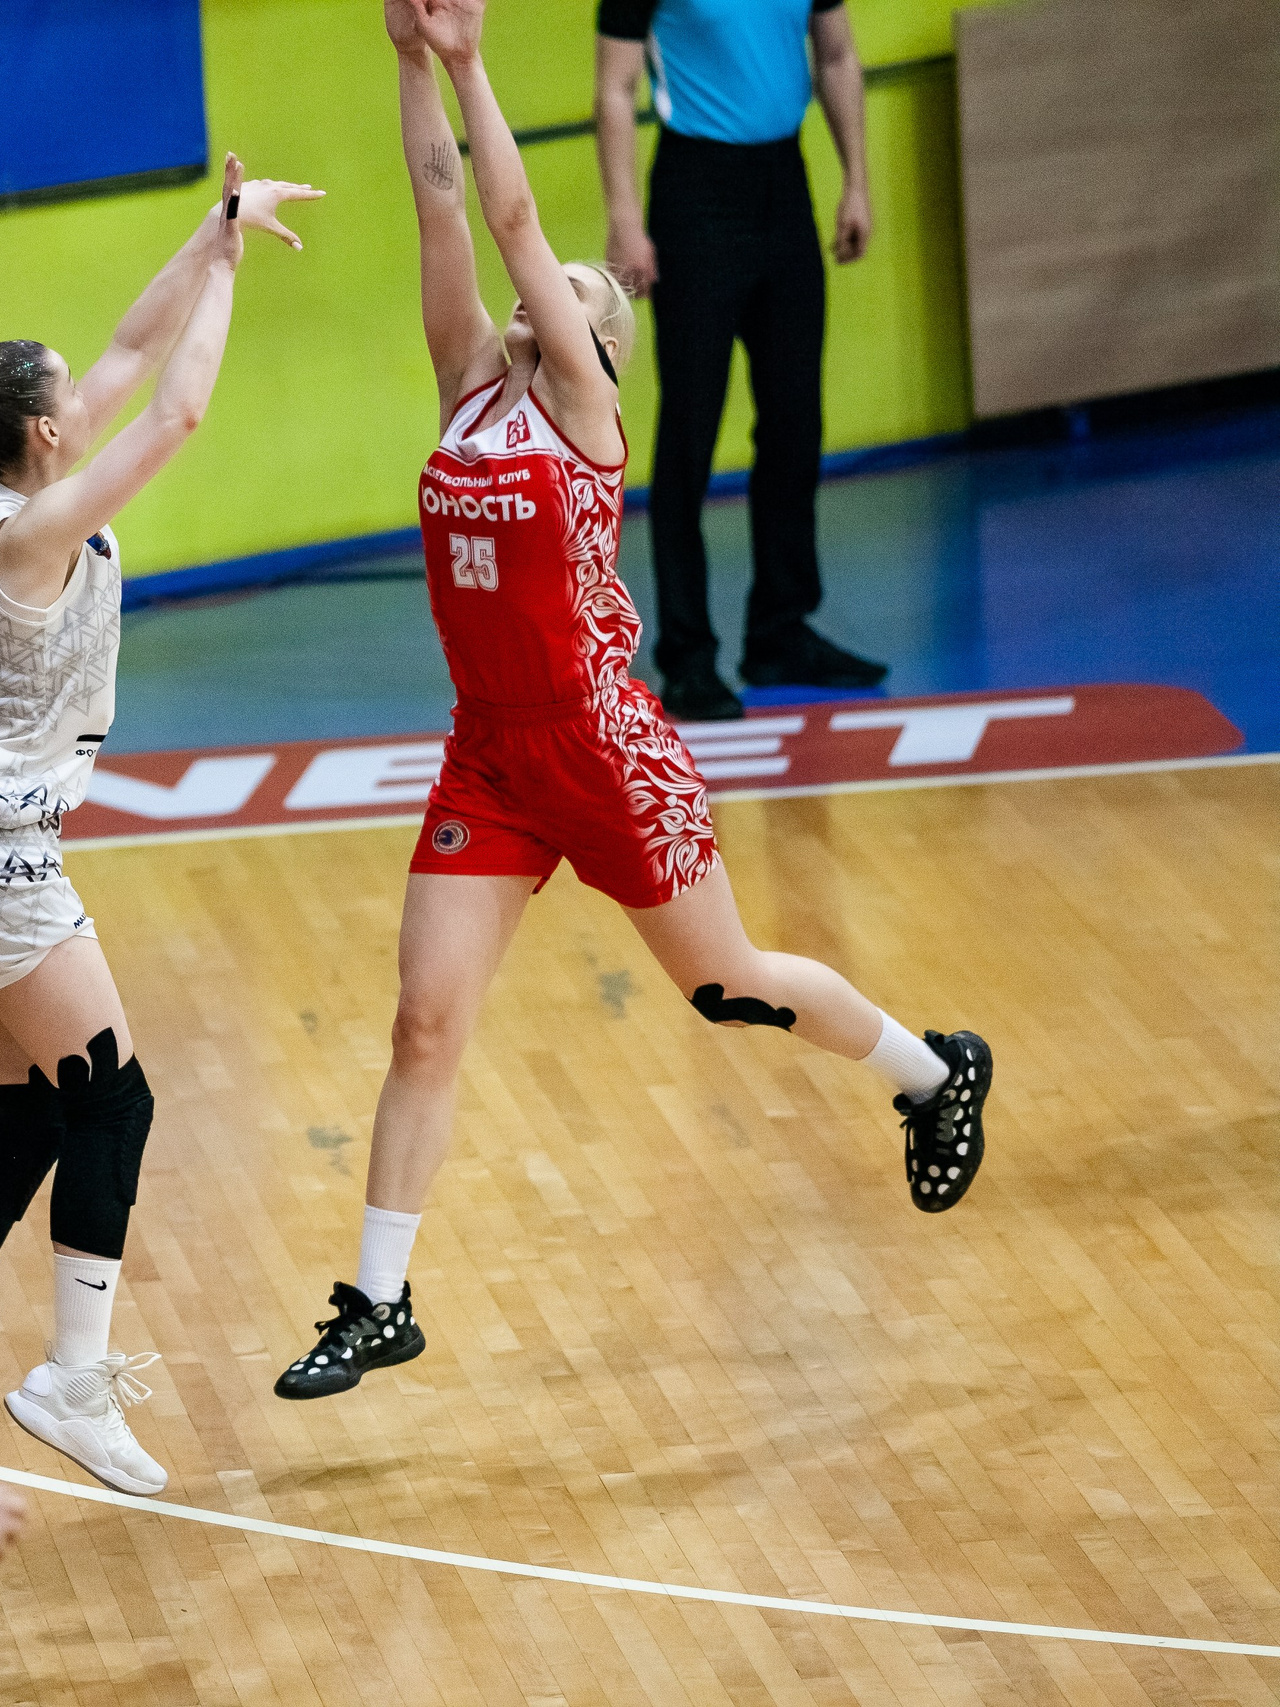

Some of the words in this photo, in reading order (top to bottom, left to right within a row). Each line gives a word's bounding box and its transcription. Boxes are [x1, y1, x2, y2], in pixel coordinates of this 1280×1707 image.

[498, 468, 531, 485] КЛУБ
[422, 484, 537, 522] ЮНОСТЬ
[449, 533, 499, 592] 25
